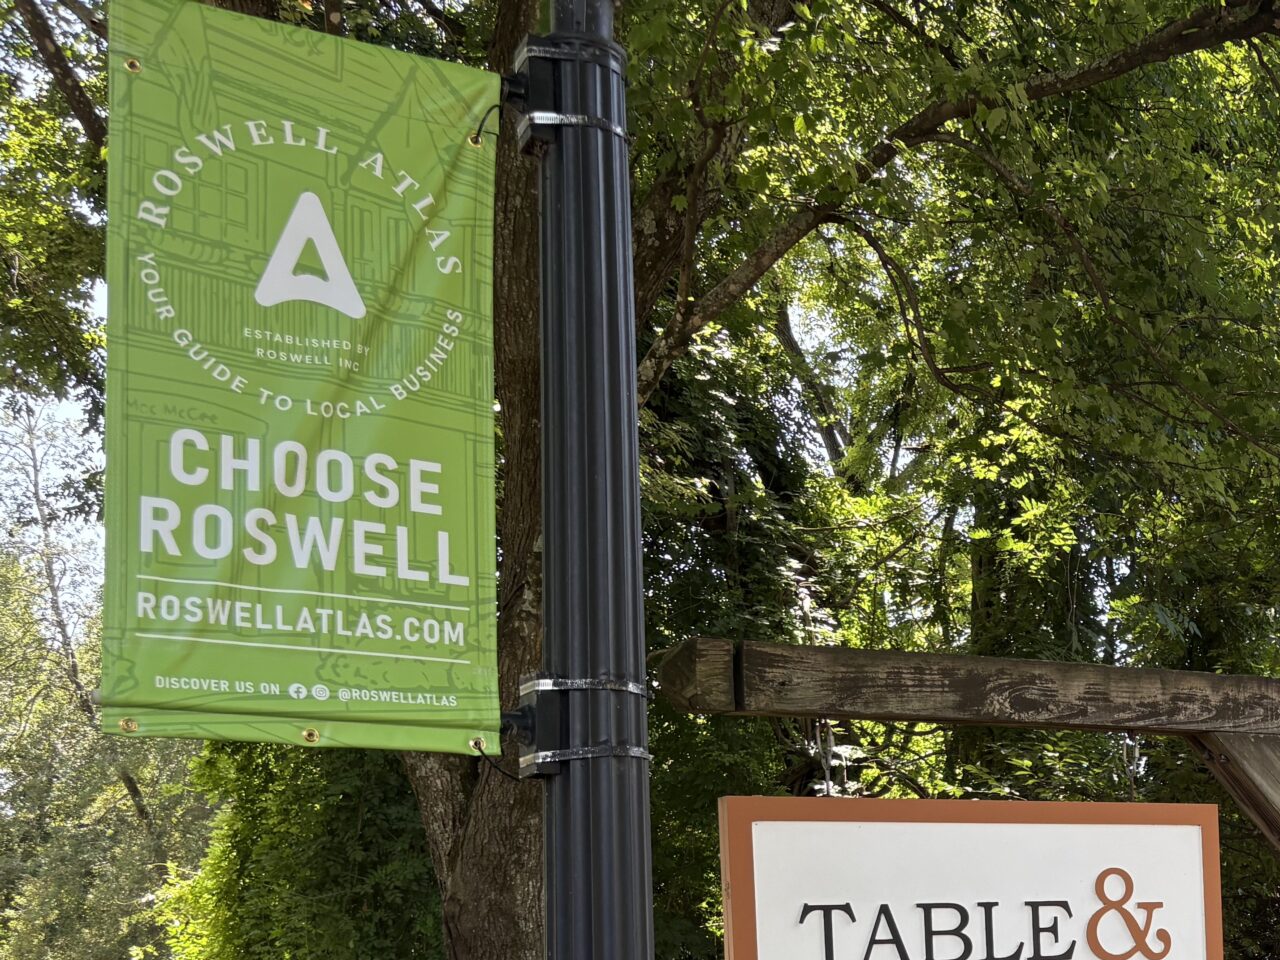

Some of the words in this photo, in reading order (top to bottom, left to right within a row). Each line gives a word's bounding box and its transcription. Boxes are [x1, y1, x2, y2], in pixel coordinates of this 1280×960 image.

[138, 120, 338, 229] ROSWELL
[359, 152, 462, 275] ATLAS
[254, 191, 367, 319] A
[137, 253, 175, 320] YOUR
[173, 328, 248, 393] GUIDE
[258, 388, 293, 411] TO
[306, 396, 386, 418] LOCAL
[389, 309, 463, 400] BUSINESS
[244, 327, 352, 350] ESTABLISHED
[356, 344, 370, 357] BY
[256, 347, 331, 365] ROSWELL
[339, 357, 360, 372] INC
[169, 428, 443, 516] CHOOSE
[139, 495, 470, 587] ROSWELL
[136, 591, 466, 647] ROSWELLATLAS.COM
[155, 675, 229, 692] DISCOVER
[235, 681, 254, 694] US
[260, 682, 280, 695] ON
[338, 687, 458, 707] @ROSWELLATLAS
